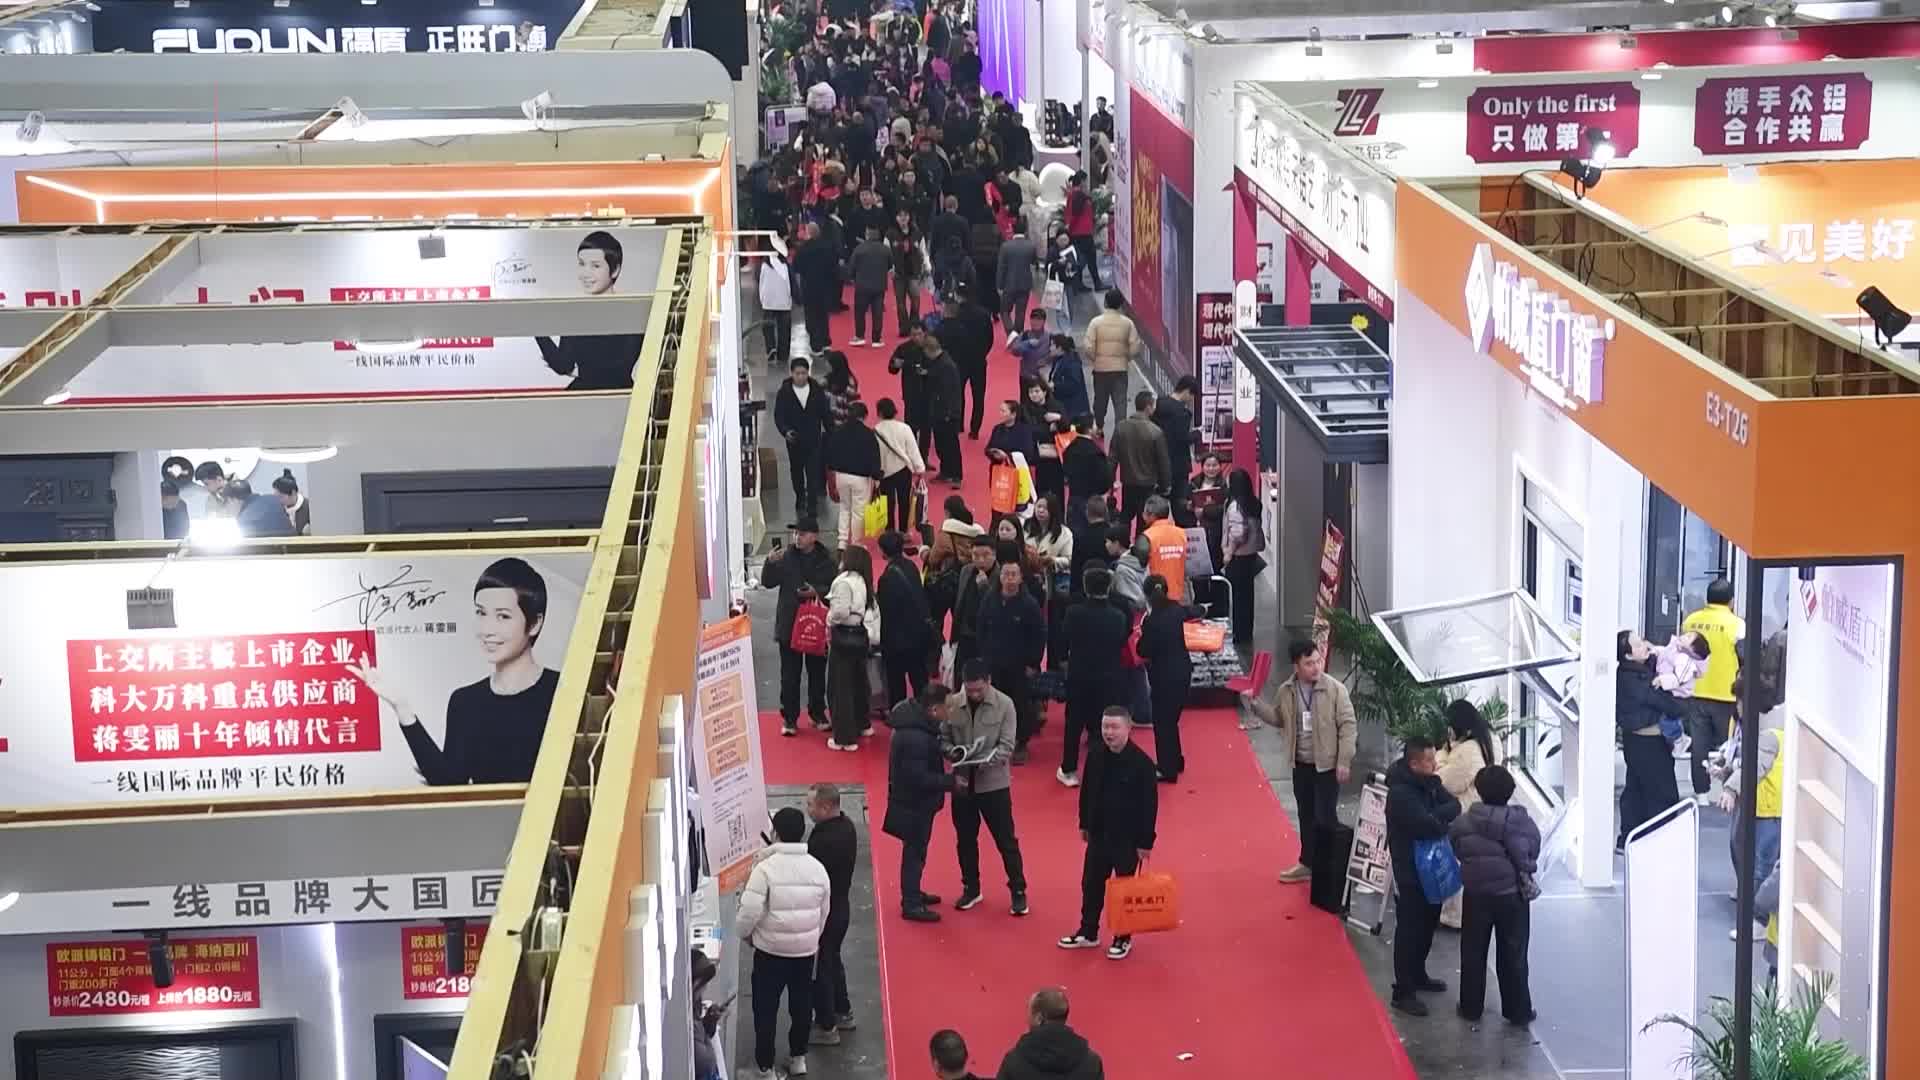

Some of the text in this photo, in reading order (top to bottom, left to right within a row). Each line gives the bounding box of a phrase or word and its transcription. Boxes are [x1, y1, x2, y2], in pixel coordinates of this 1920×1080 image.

[1484, 94, 1616, 119] Only the first
[1724, 83, 1846, 116] 携手众铝
[1723, 114, 1845, 147] 合作共赢
[1706, 391, 1748, 445] E3-T26
[87, 639, 356, 675] 上交所主板上市企业
[89, 676, 357, 713] 科大万科重点供应商
[93, 716, 359, 754] 蒋雯丽十年倾情代言
[92, 763, 346, 794] 一线国际品牌平民价格
[112, 876, 503, 919] 一线品牌大国匠
